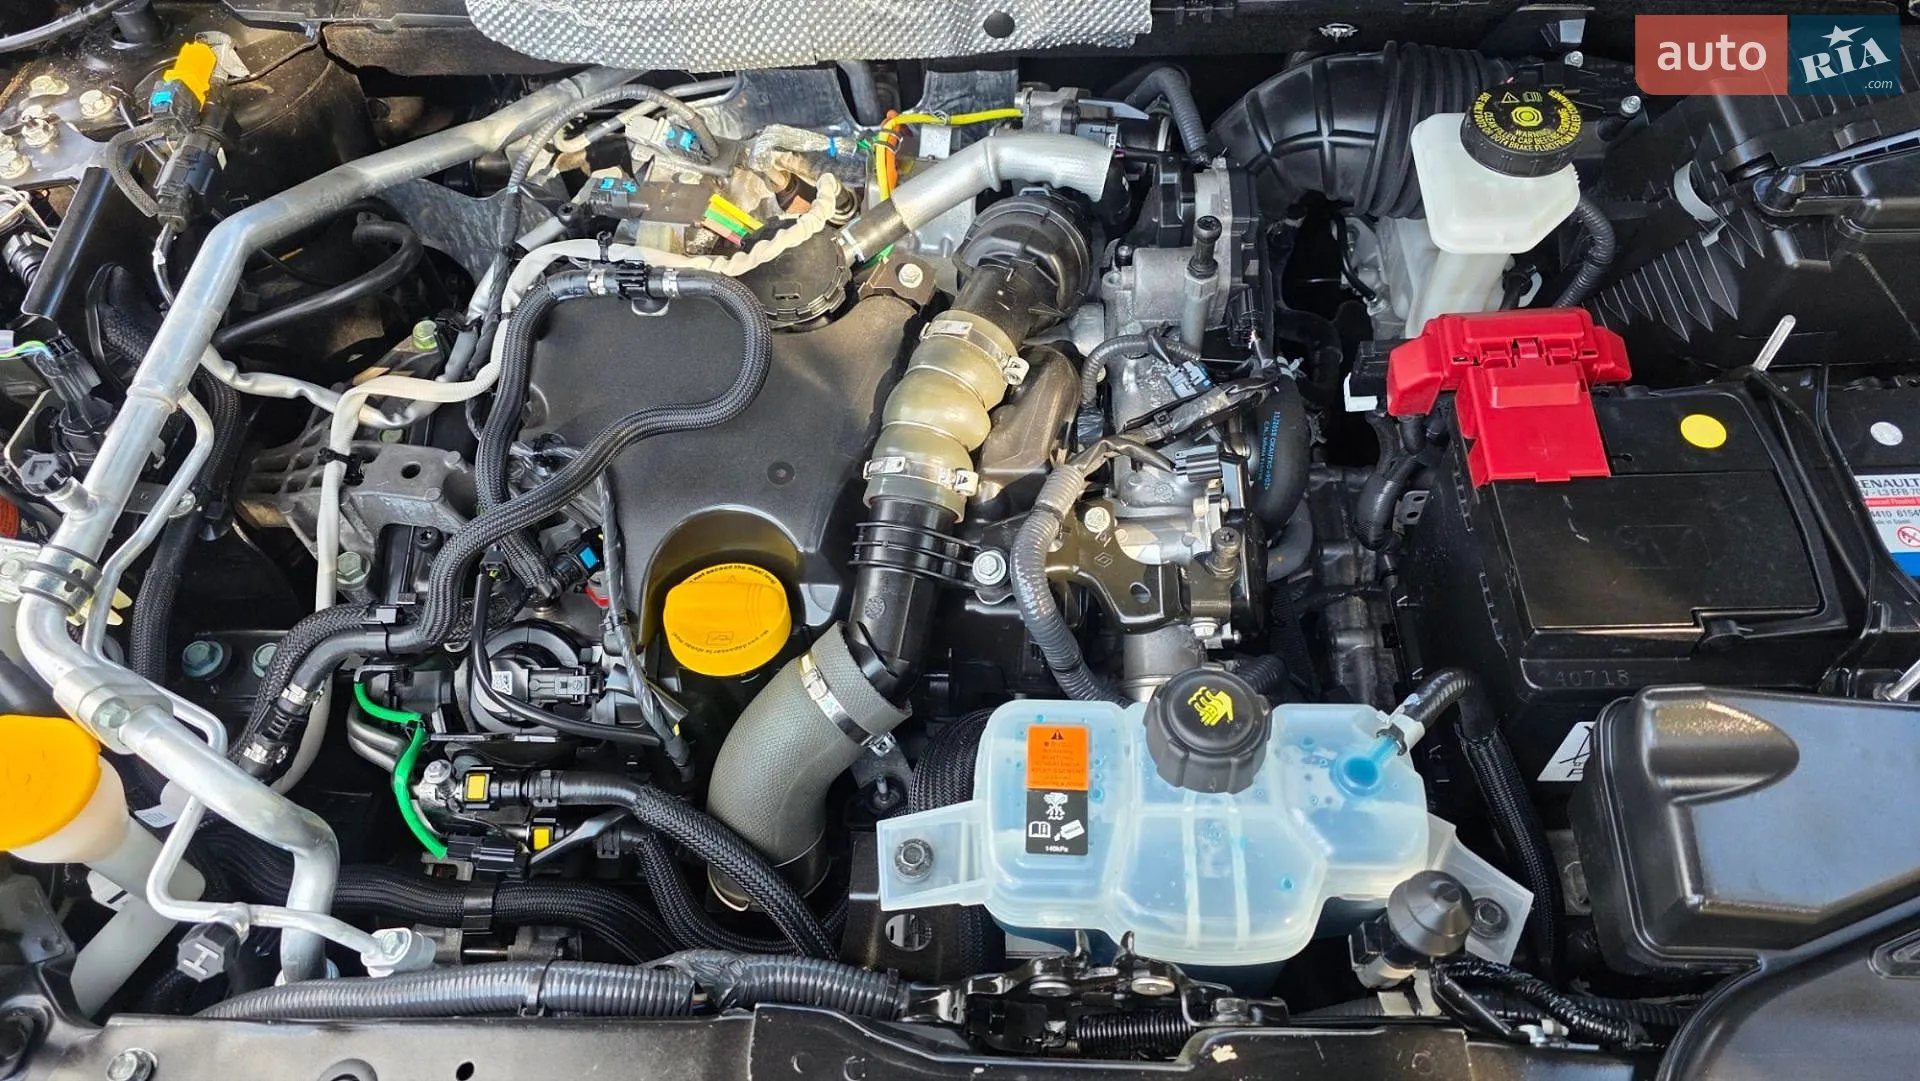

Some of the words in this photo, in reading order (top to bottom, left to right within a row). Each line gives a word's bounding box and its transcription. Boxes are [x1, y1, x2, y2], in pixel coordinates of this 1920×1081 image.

[1517, 136, 1534, 144] CAP
[1507, 141, 1534, 151] BRAKE
[183, 943, 220, 976] H
